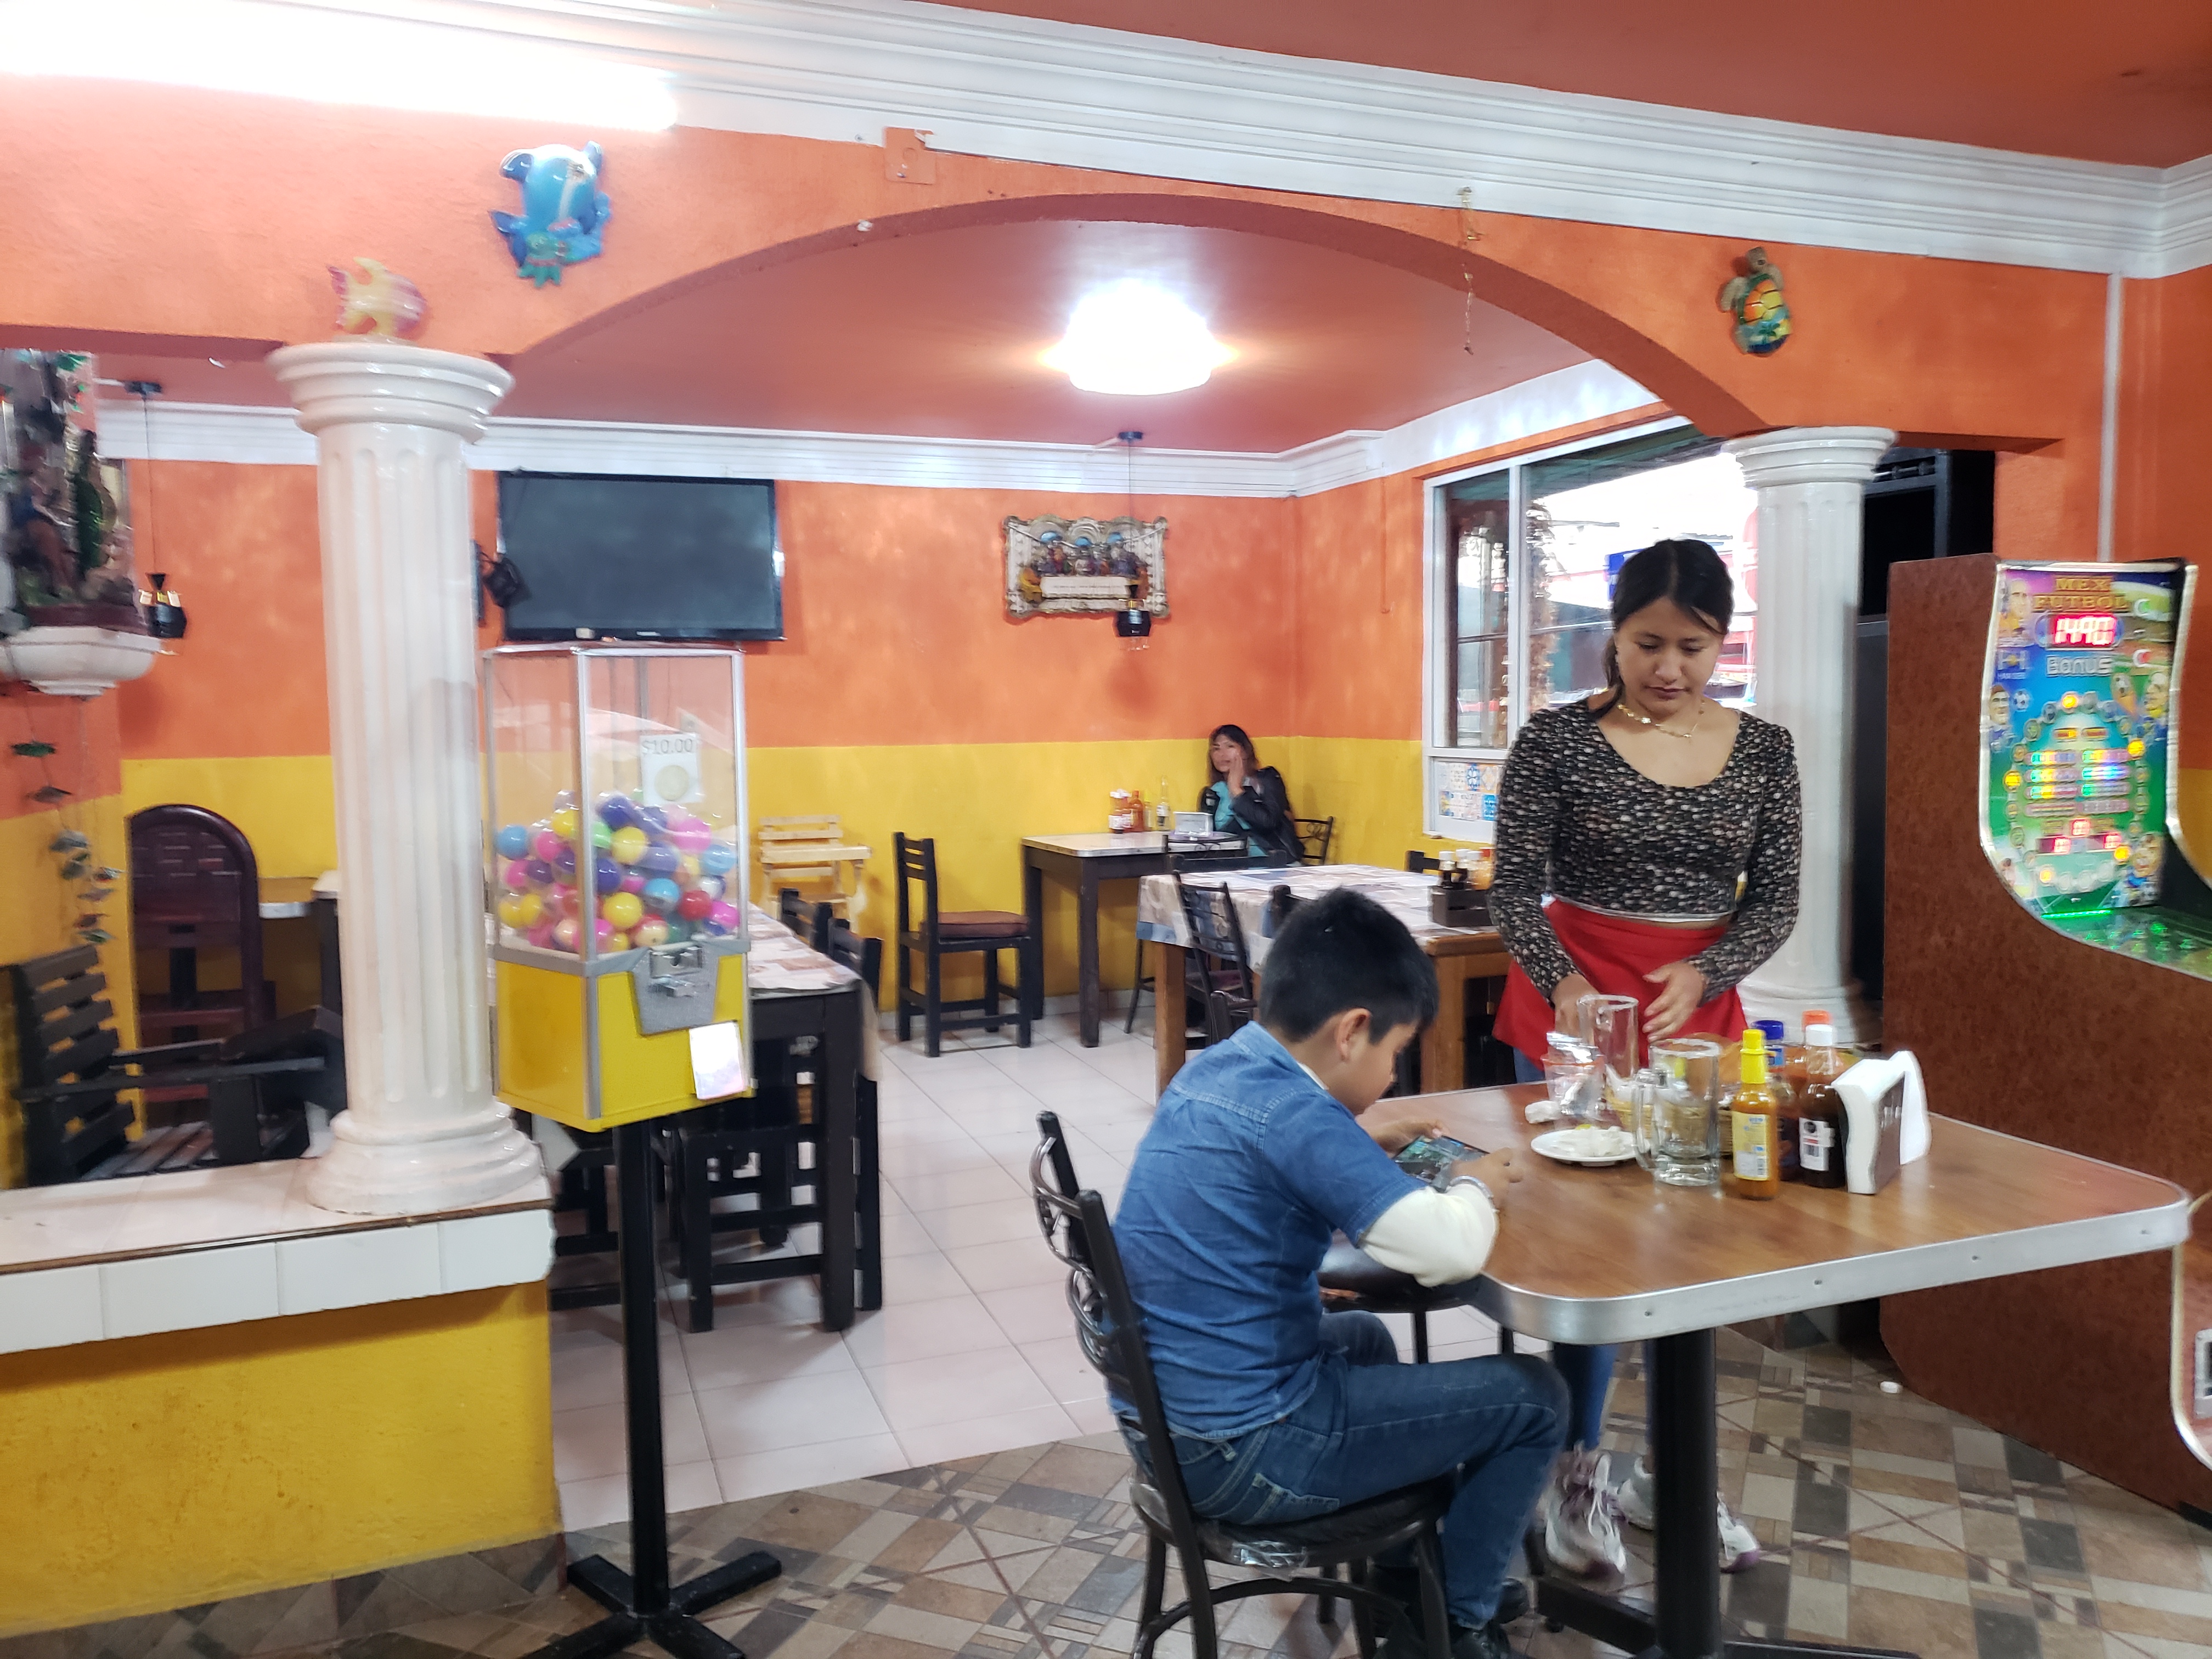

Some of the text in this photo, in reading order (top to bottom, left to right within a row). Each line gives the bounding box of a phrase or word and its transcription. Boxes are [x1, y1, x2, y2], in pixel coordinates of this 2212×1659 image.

[2056, 578, 2112, 591] MEX
[2034, 595, 2129, 609] FUTBOL
[641, 738, 693, 755] $10.00
